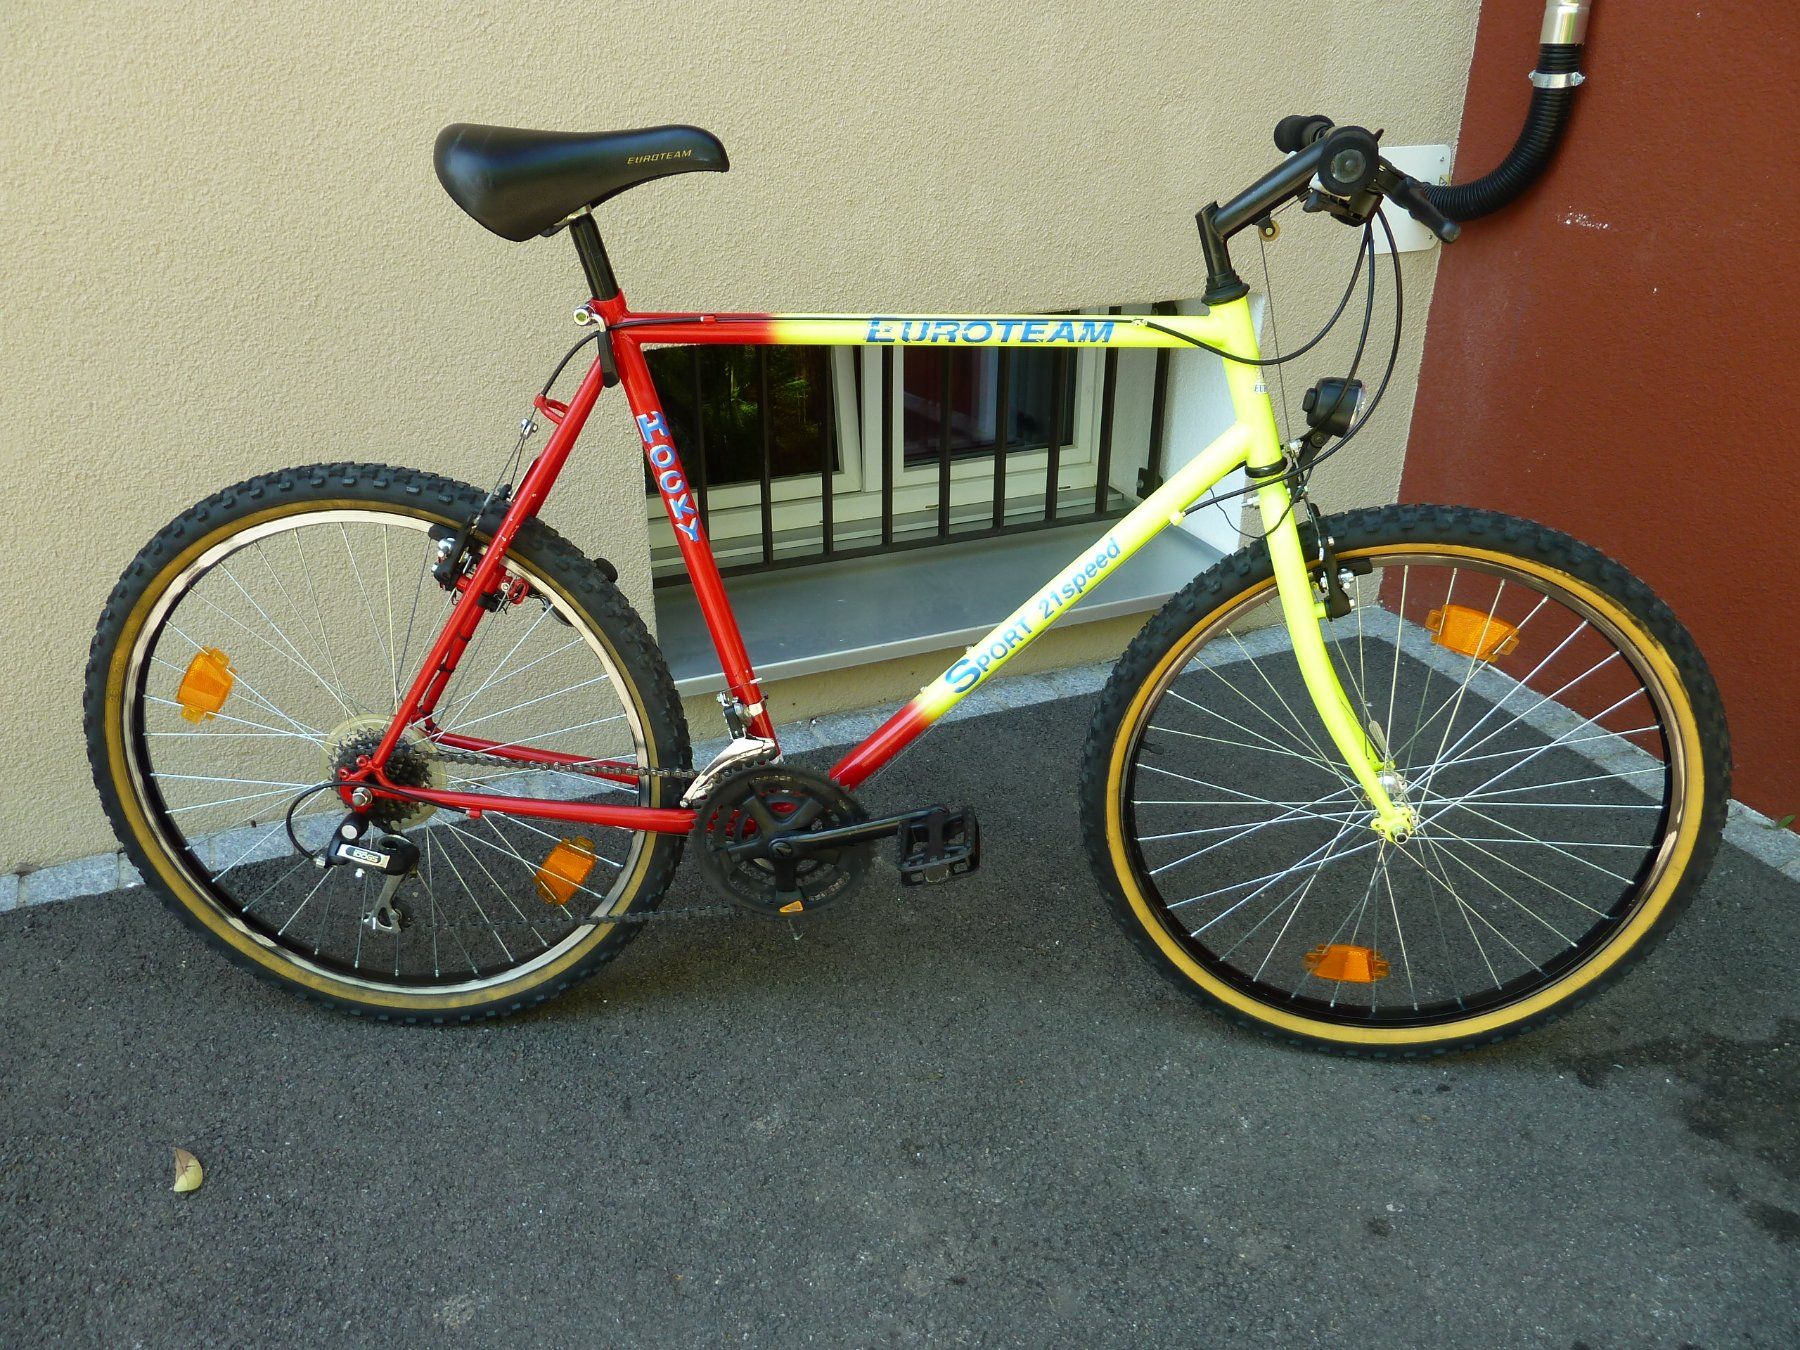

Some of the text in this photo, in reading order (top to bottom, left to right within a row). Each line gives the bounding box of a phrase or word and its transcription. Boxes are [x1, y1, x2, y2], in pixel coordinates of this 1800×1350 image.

[626, 149, 692, 165] EUROTEAM
[865, 316, 1115, 343] EUROTEAM
[636, 410, 700, 542] HOCKY
[945, 616, 1033, 694] SPORT
